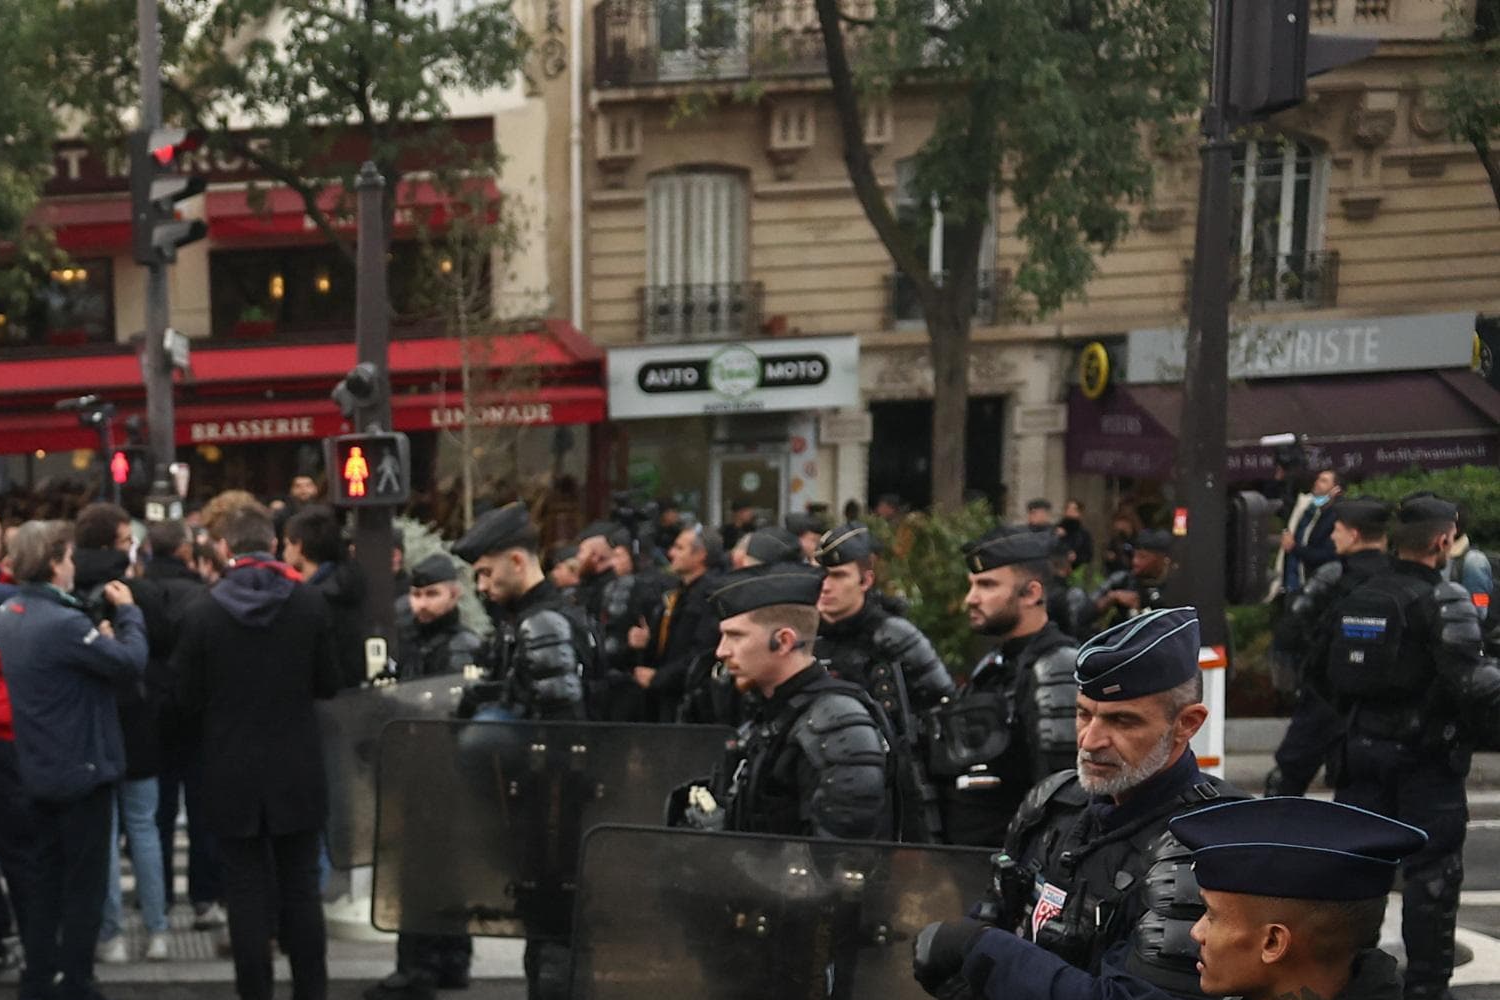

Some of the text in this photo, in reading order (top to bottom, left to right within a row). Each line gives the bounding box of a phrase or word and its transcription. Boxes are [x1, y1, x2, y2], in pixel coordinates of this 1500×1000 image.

[643, 367, 700, 387] AUTO
[764, 359, 825, 380] MOTO
[190, 417, 315, 441] BRASSERIE
